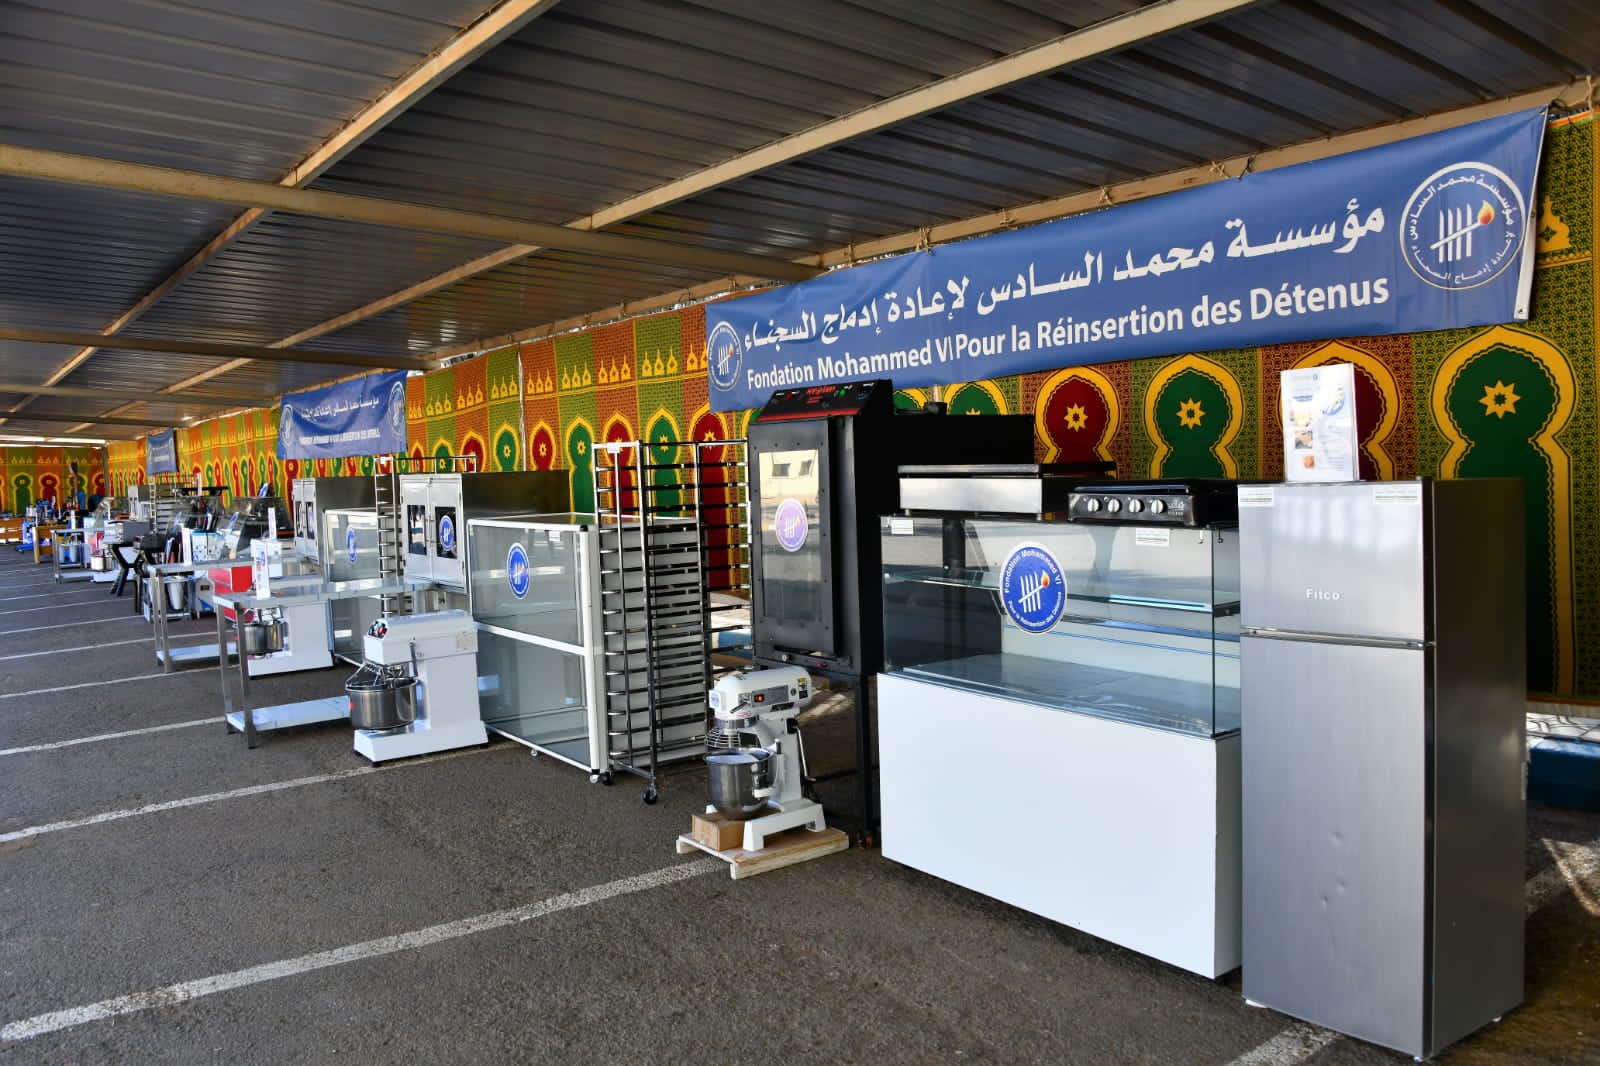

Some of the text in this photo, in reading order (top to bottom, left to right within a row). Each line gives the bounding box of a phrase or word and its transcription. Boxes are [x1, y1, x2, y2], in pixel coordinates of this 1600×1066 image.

[744, 198, 1384, 352] مؤسسة محمد السادس لإعادة إدماج السجناء
[747, 363, 815, 391] Fondation
[817, 342, 932, 381] Mohammed
[955, 332, 1007, 359] Pour
[1011, 323, 1032, 352] la
[1037, 303, 1183, 350] Réinsertion
[1191, 294, 1243, 328] des
[1250, 277, 1390, 321] Détenus
